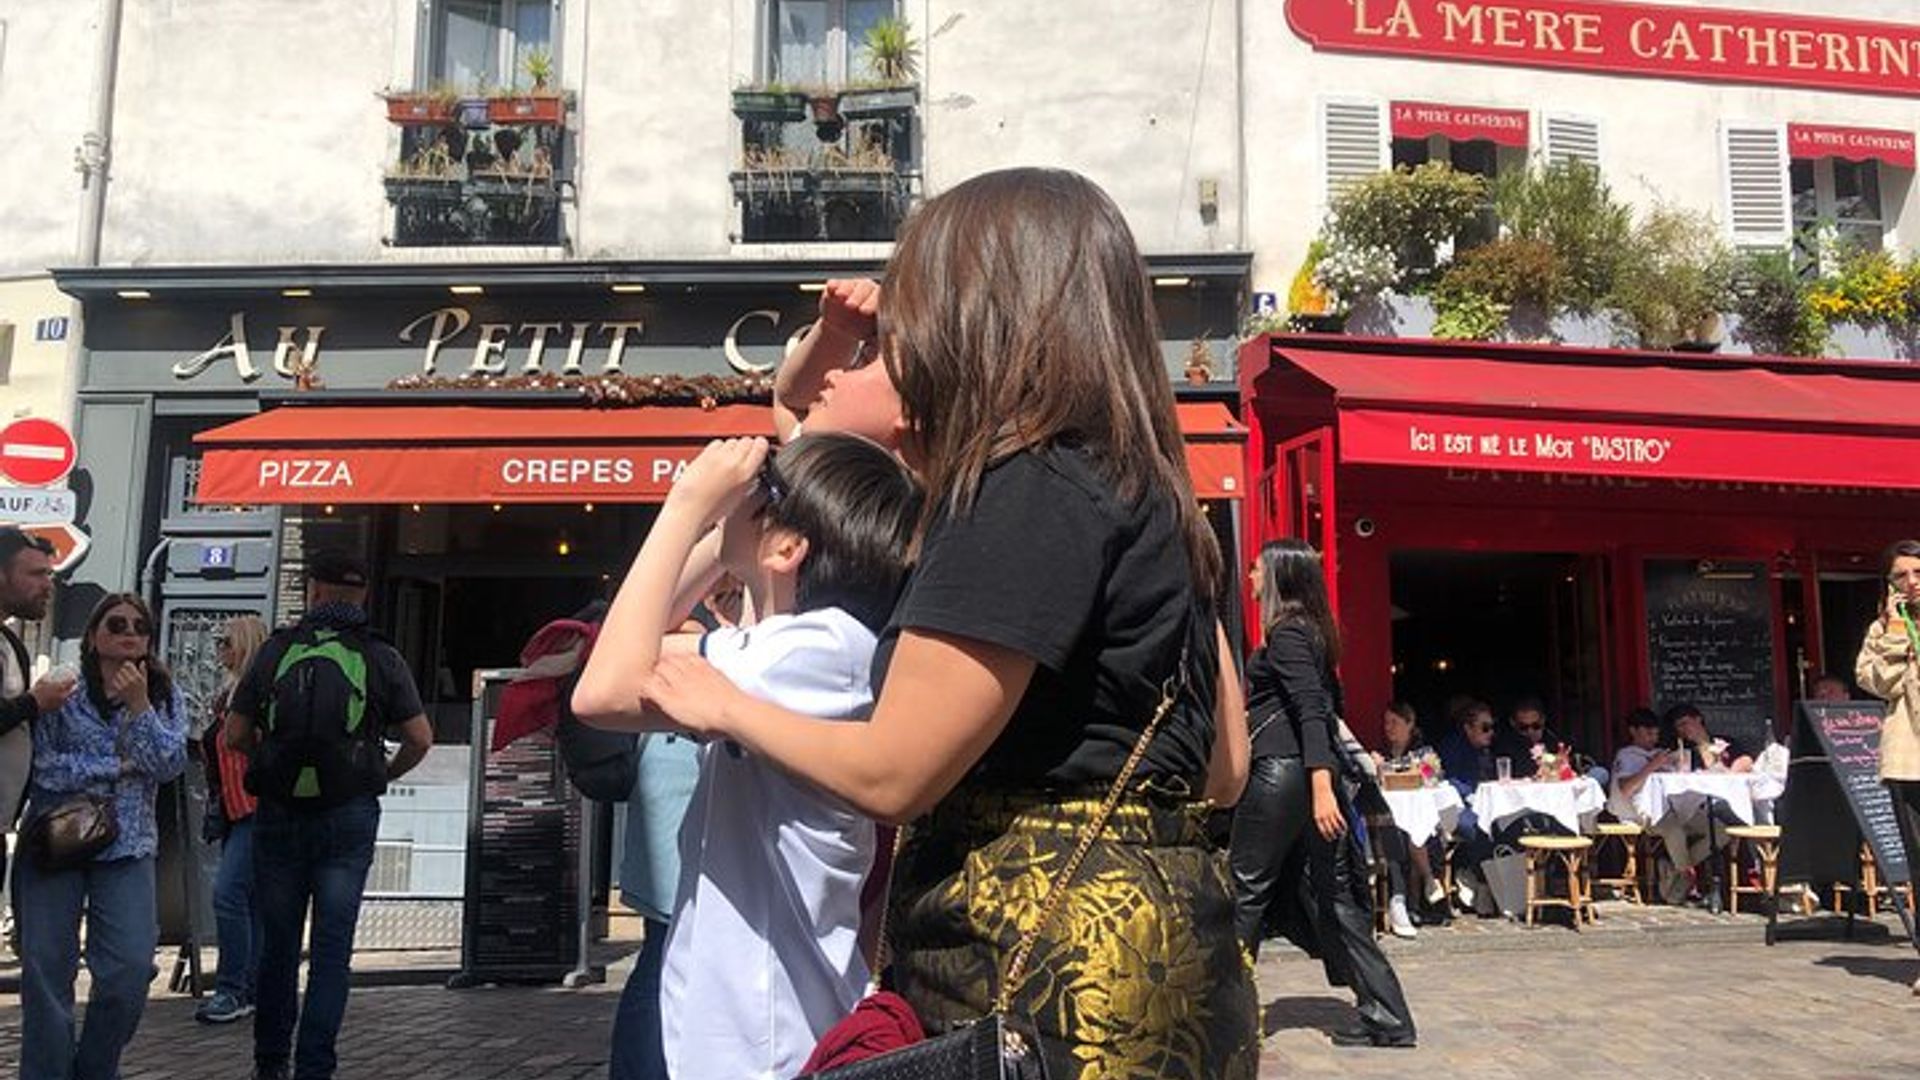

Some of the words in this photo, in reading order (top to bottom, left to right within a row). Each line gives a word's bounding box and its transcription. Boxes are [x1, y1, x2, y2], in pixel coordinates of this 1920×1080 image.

[1348, 0, 1421, 38] LA
[1437, 1, 1604, 53] MERE
[1394, 107, 1413, 121] LA
[1794, 129, 1812, 143] LA
[42, 318, 63, 339] 10
[258, 459, 353, 487] PIZZA
[502, 458, 634, 484] CREPES
[210, 547, 223, 565] 8
